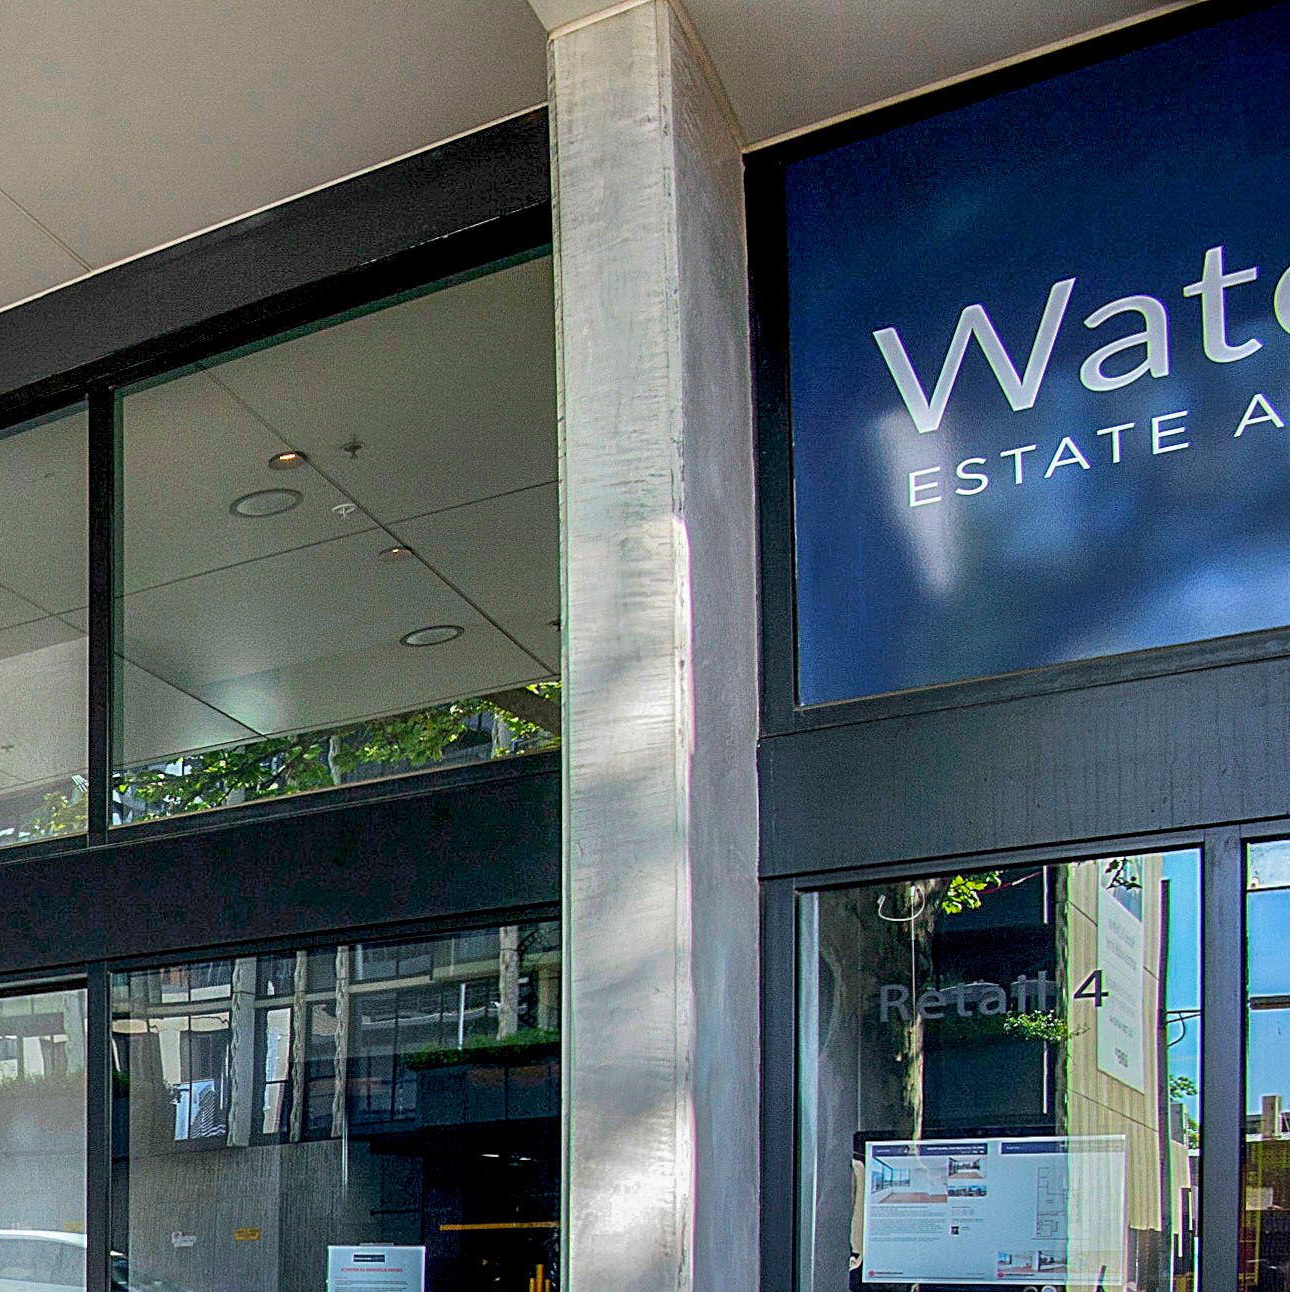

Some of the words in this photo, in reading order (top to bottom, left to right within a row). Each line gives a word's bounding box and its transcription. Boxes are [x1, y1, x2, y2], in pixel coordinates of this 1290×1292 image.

[873, 245, 1290, 433] Wat
[909, 410, 1190, 507] ESTATE
[880, 970, 1047, 1022] Retail
[1073, 969, 1109, 1008] 4
